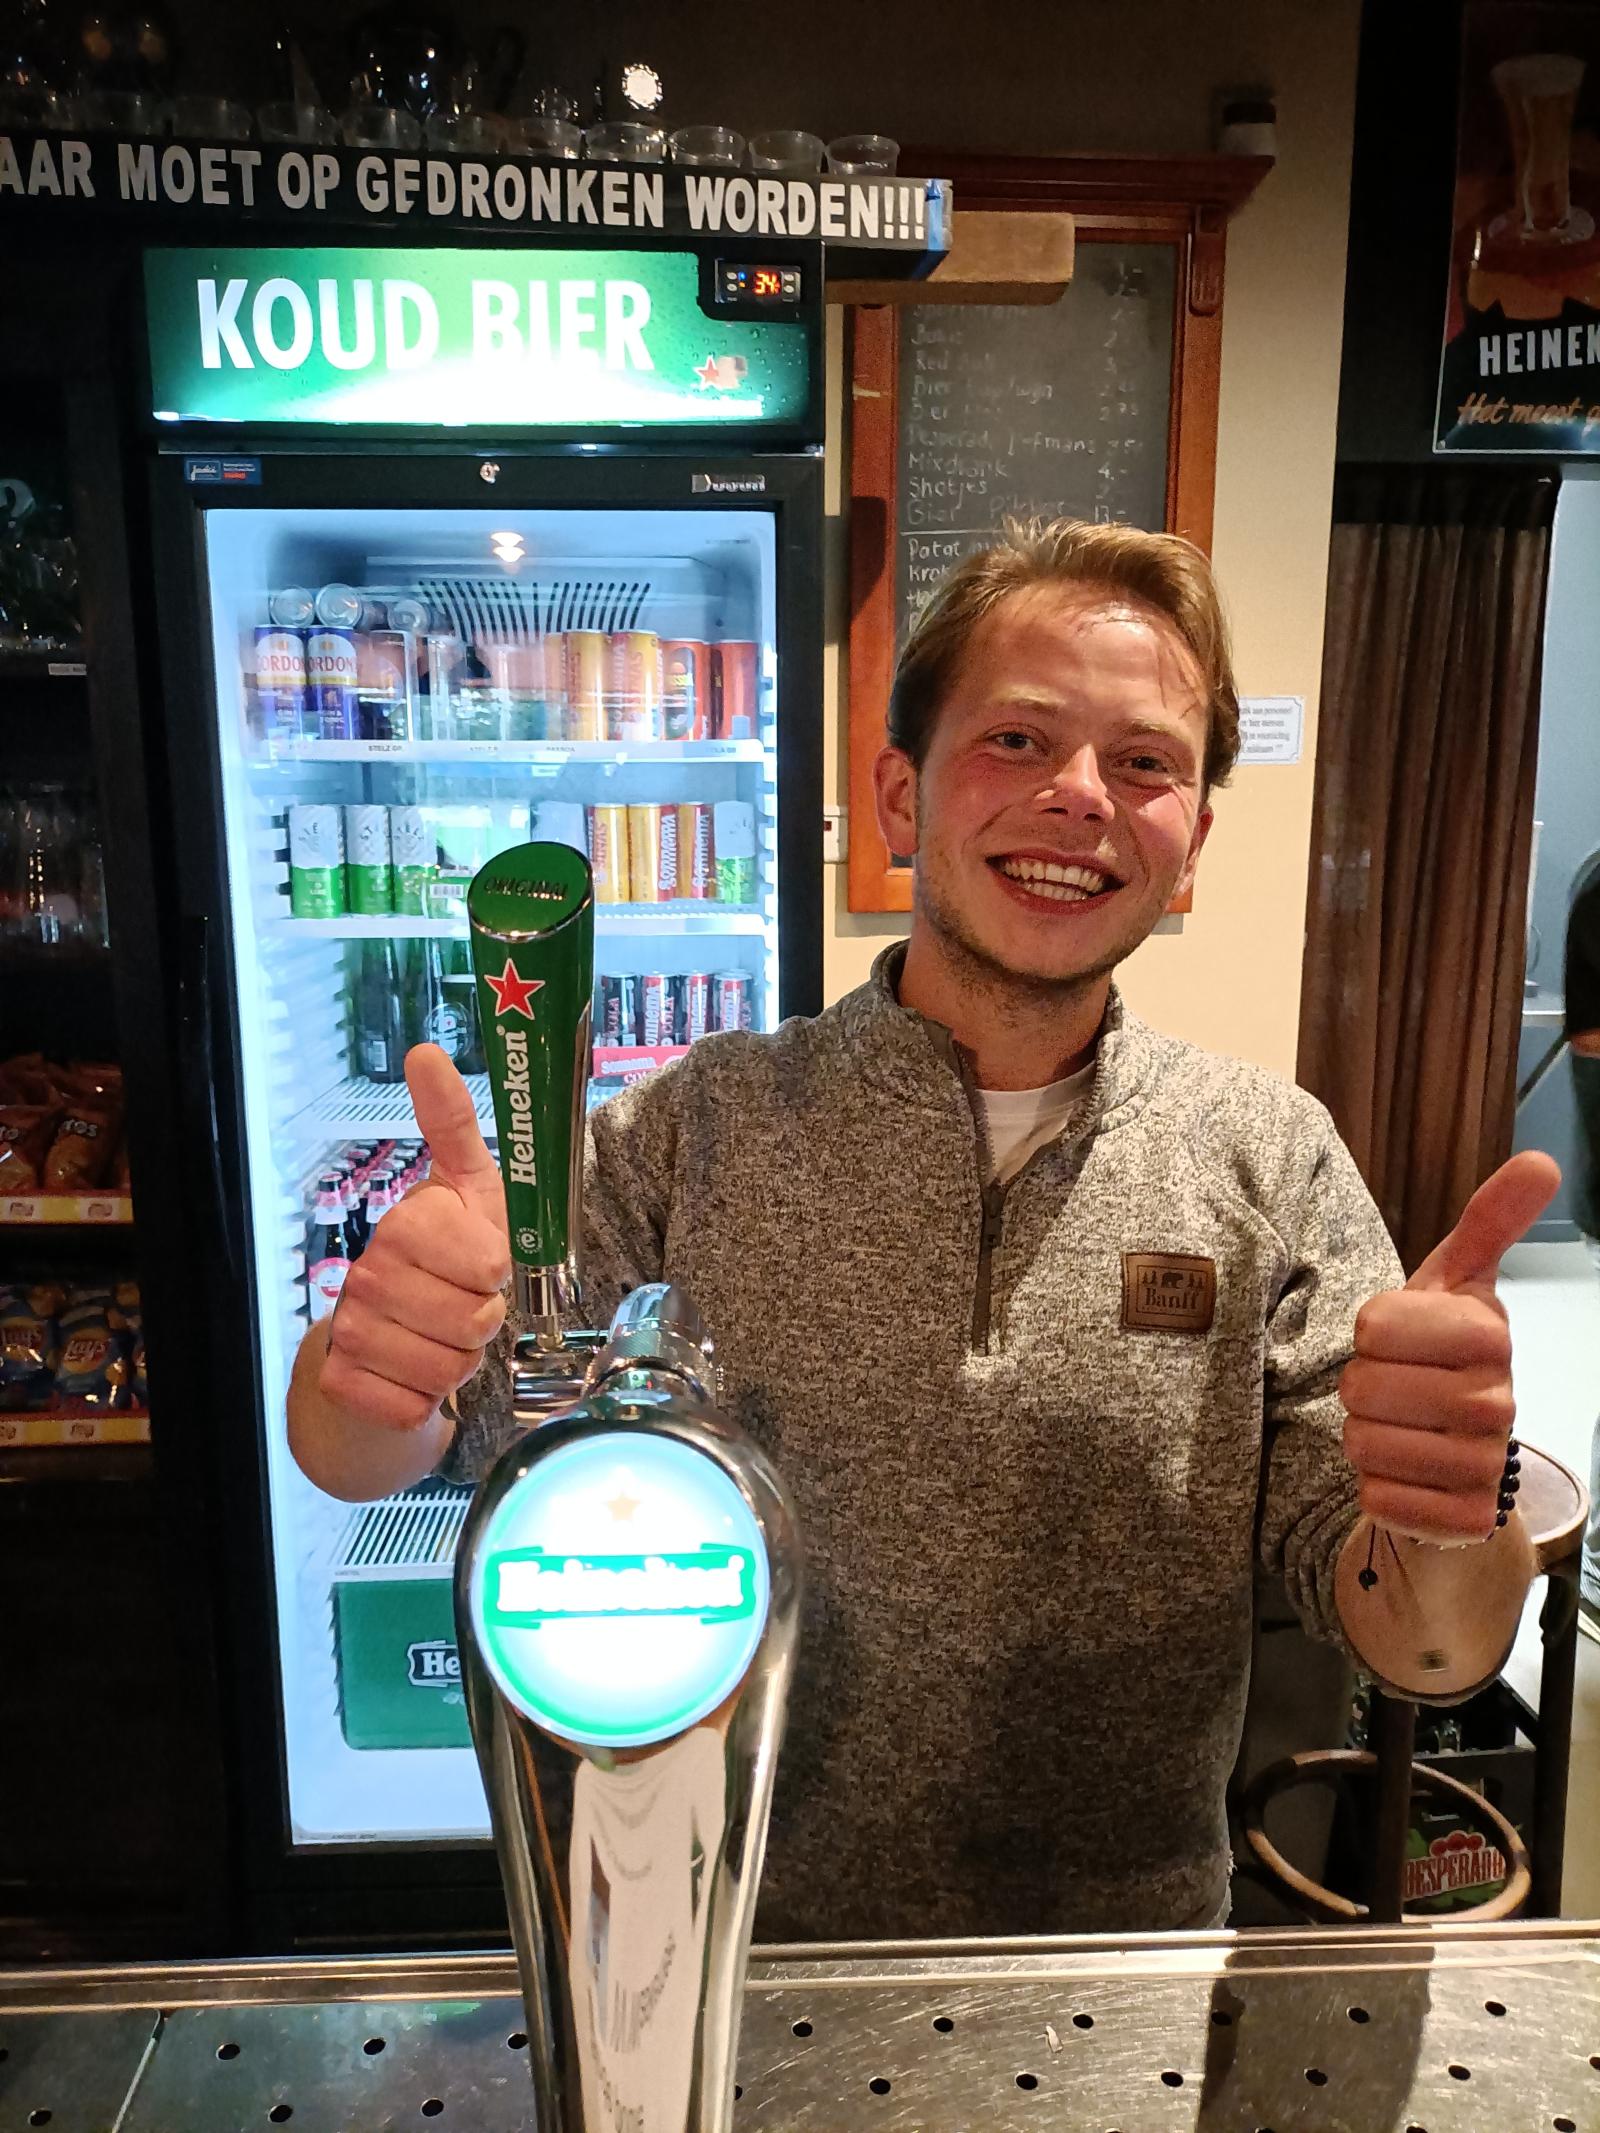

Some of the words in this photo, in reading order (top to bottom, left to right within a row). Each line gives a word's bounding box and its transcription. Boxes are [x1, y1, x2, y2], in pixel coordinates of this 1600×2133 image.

[117, 143, 262, 206] MOET
[277, 152, 341, 210] OP
[356, 156, 665, 228] GEDRONKEN
[684, 175, 926, 240] WORDEN!!!
[197, 277, 441, 371] KOUD
[470, 278, 656, 371] BIER
[502, 1029, 537, 1187] Heineken
